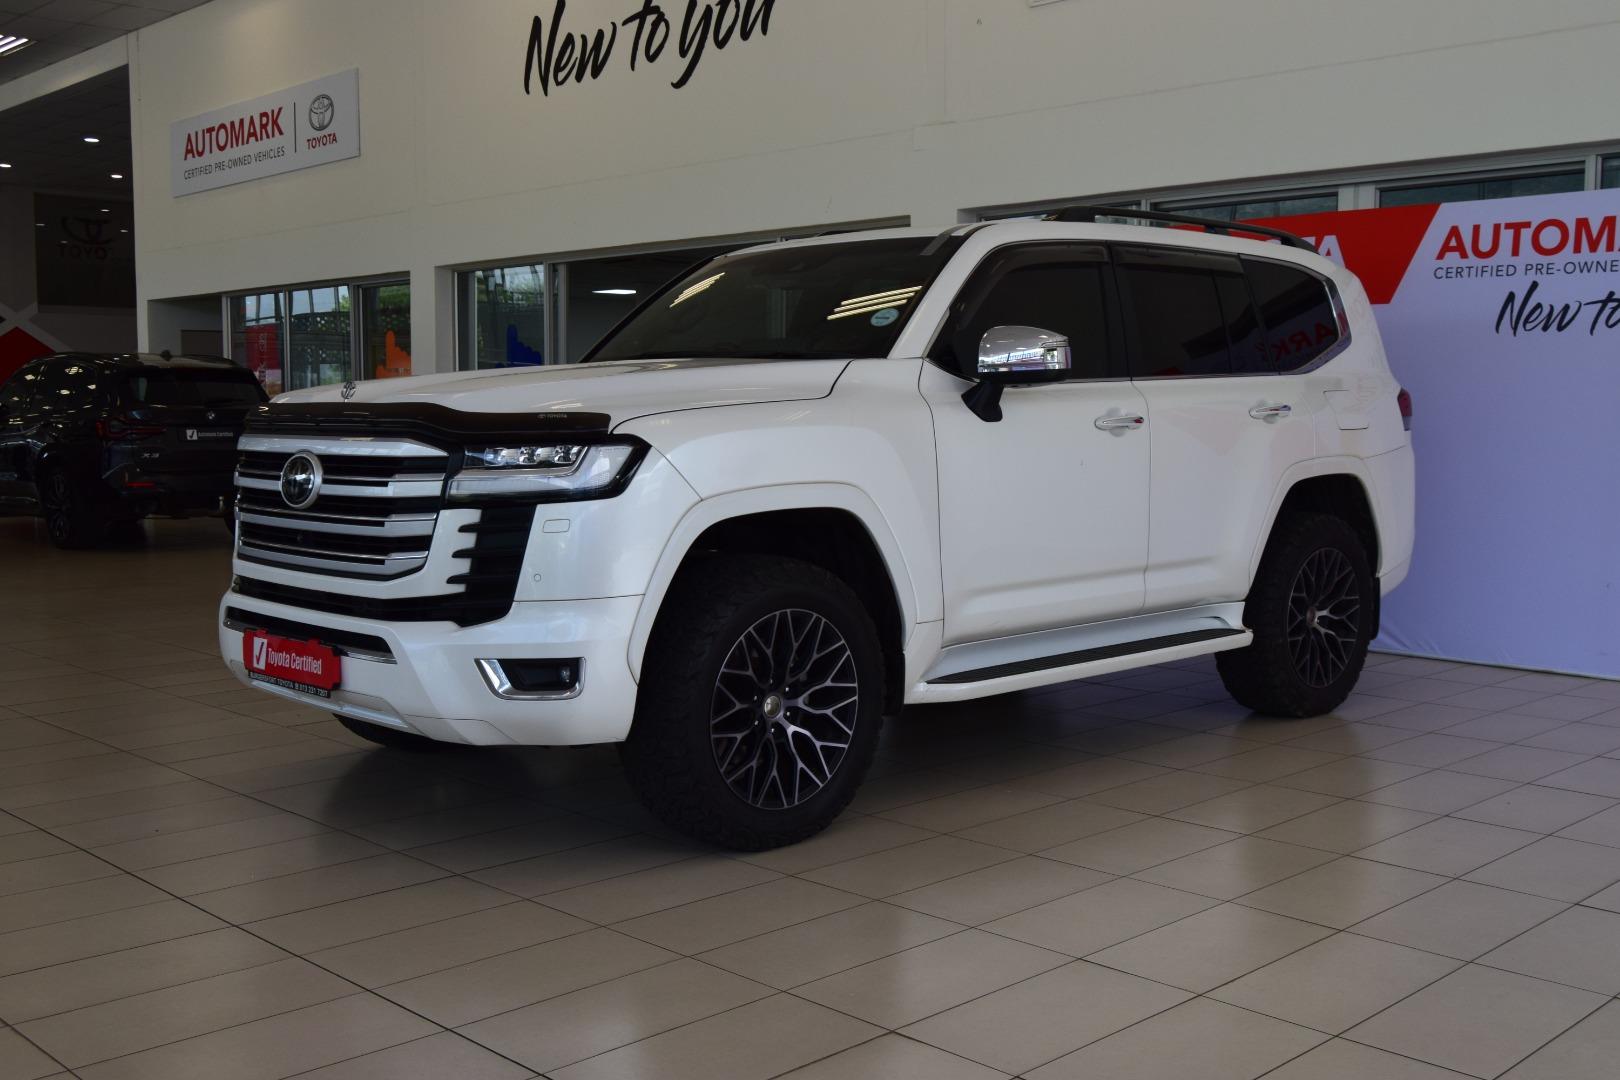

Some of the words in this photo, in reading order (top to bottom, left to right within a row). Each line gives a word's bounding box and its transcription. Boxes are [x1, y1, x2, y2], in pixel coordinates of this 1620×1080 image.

[524, 0, 617, 97] New
[621, 0, 671, 72] to
[184, 107, 284, 161] AUTOMARK
[306, 132, 338, 151] TOYOTA
[183, 164, 213, 181] CERTIFIED
[214, 154, 253, 172] PRE-OWNED
[253, 145, 286, 162] VEHICLES
[1435, 215, 1620, 261] AUTOM
[1433, 264, 1518, 280] CERTIFIED
[1524, 259, 1620, 277] PRE-OWNE
[1495, 280, 1582, 337] New
[267, 647, 290, 668] Toyota
[290, 652, 322, 675] Certified
